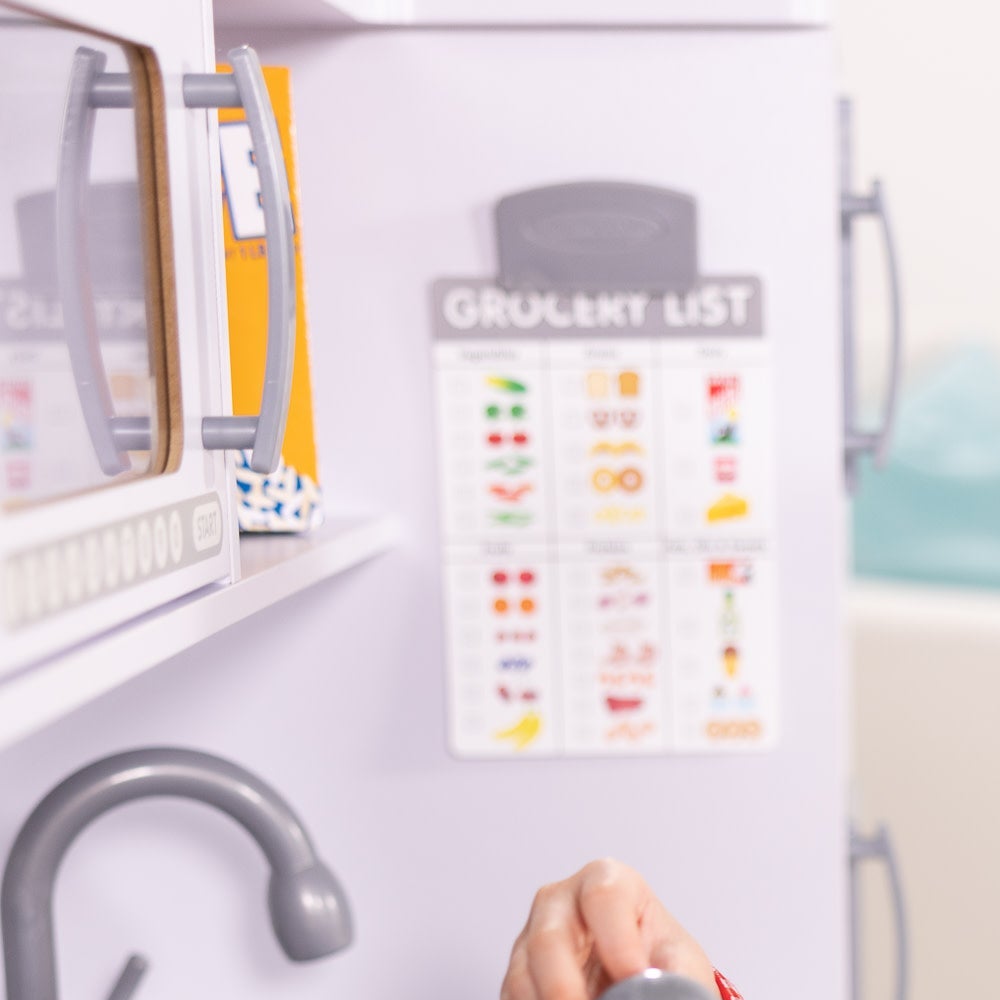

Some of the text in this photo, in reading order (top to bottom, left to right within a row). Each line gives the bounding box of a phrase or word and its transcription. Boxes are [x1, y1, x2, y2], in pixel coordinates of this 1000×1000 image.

[443, 283, 754, 330] GROCERY LIST
[197, 511, 217, 541] START
